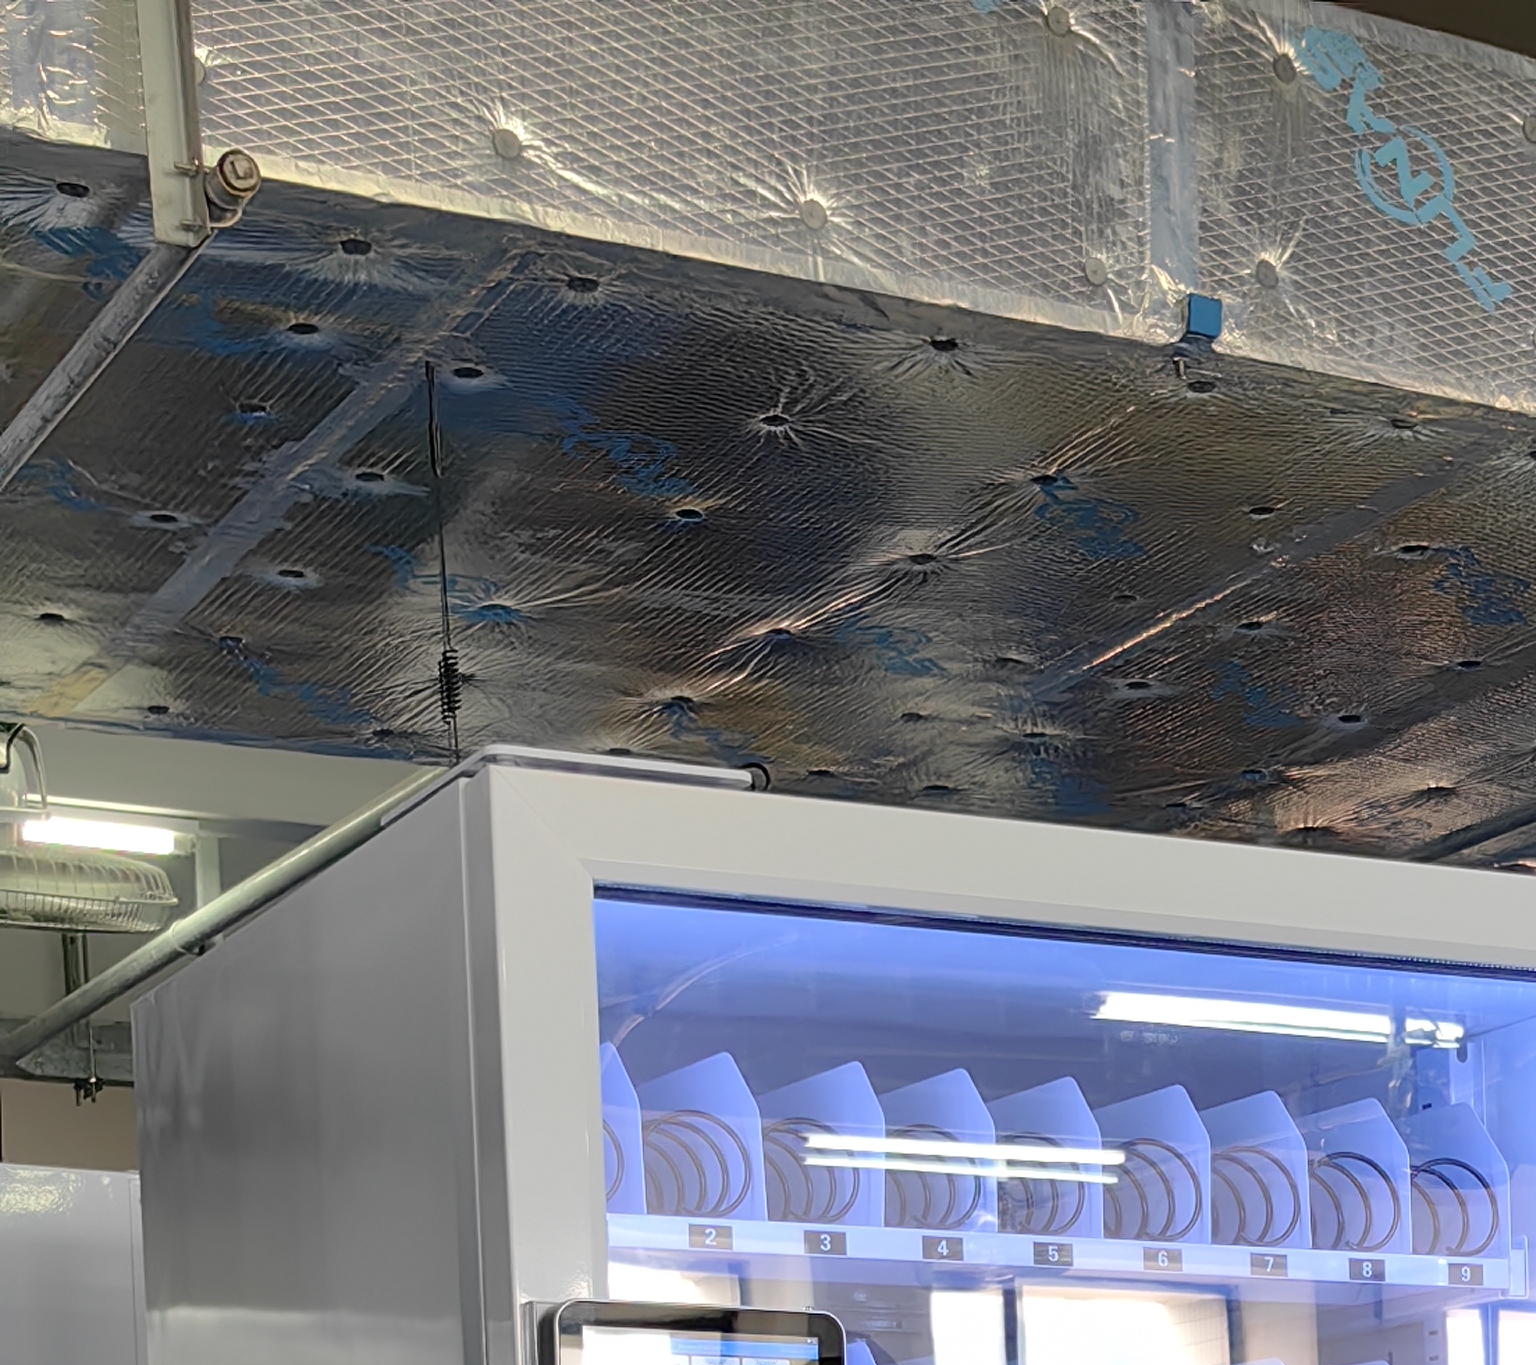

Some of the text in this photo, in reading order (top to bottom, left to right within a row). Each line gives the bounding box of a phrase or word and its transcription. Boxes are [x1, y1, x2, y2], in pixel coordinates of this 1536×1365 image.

[704, 1228, 1472, 1282] 2 3 4 5 6 7 8 9
